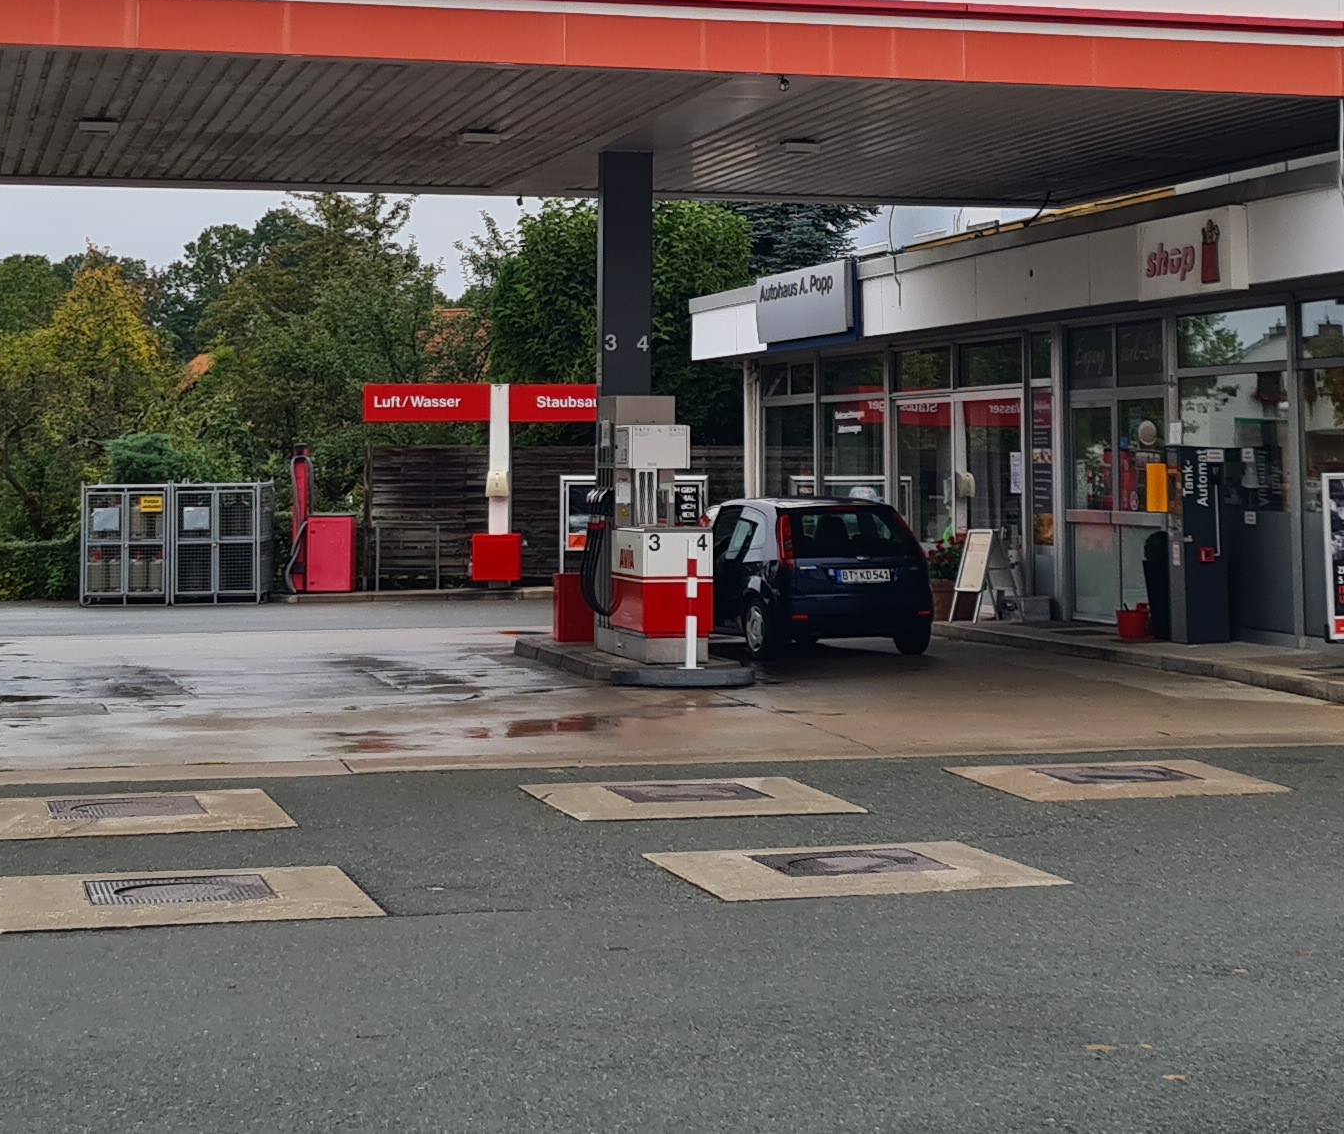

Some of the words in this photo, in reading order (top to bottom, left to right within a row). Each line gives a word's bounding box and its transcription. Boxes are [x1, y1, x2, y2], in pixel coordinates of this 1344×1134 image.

[1146, 242, 1196, 282] shop
[760, 281, 799, 303] Autohaus
[810, 275, 834, 296] Popp
[605, 334, 617, 351] 3
[636, 335, 650, 352] 4
[1182, 459, 1194, 497] Tank-
[1196, 449, 1209, 507] Automat
[649, 534, 661, 552] 3
[697, 534, 708, 551] 4
[842, 570, 854, 580] BT
[1338, 576, 1344, 584] 5
